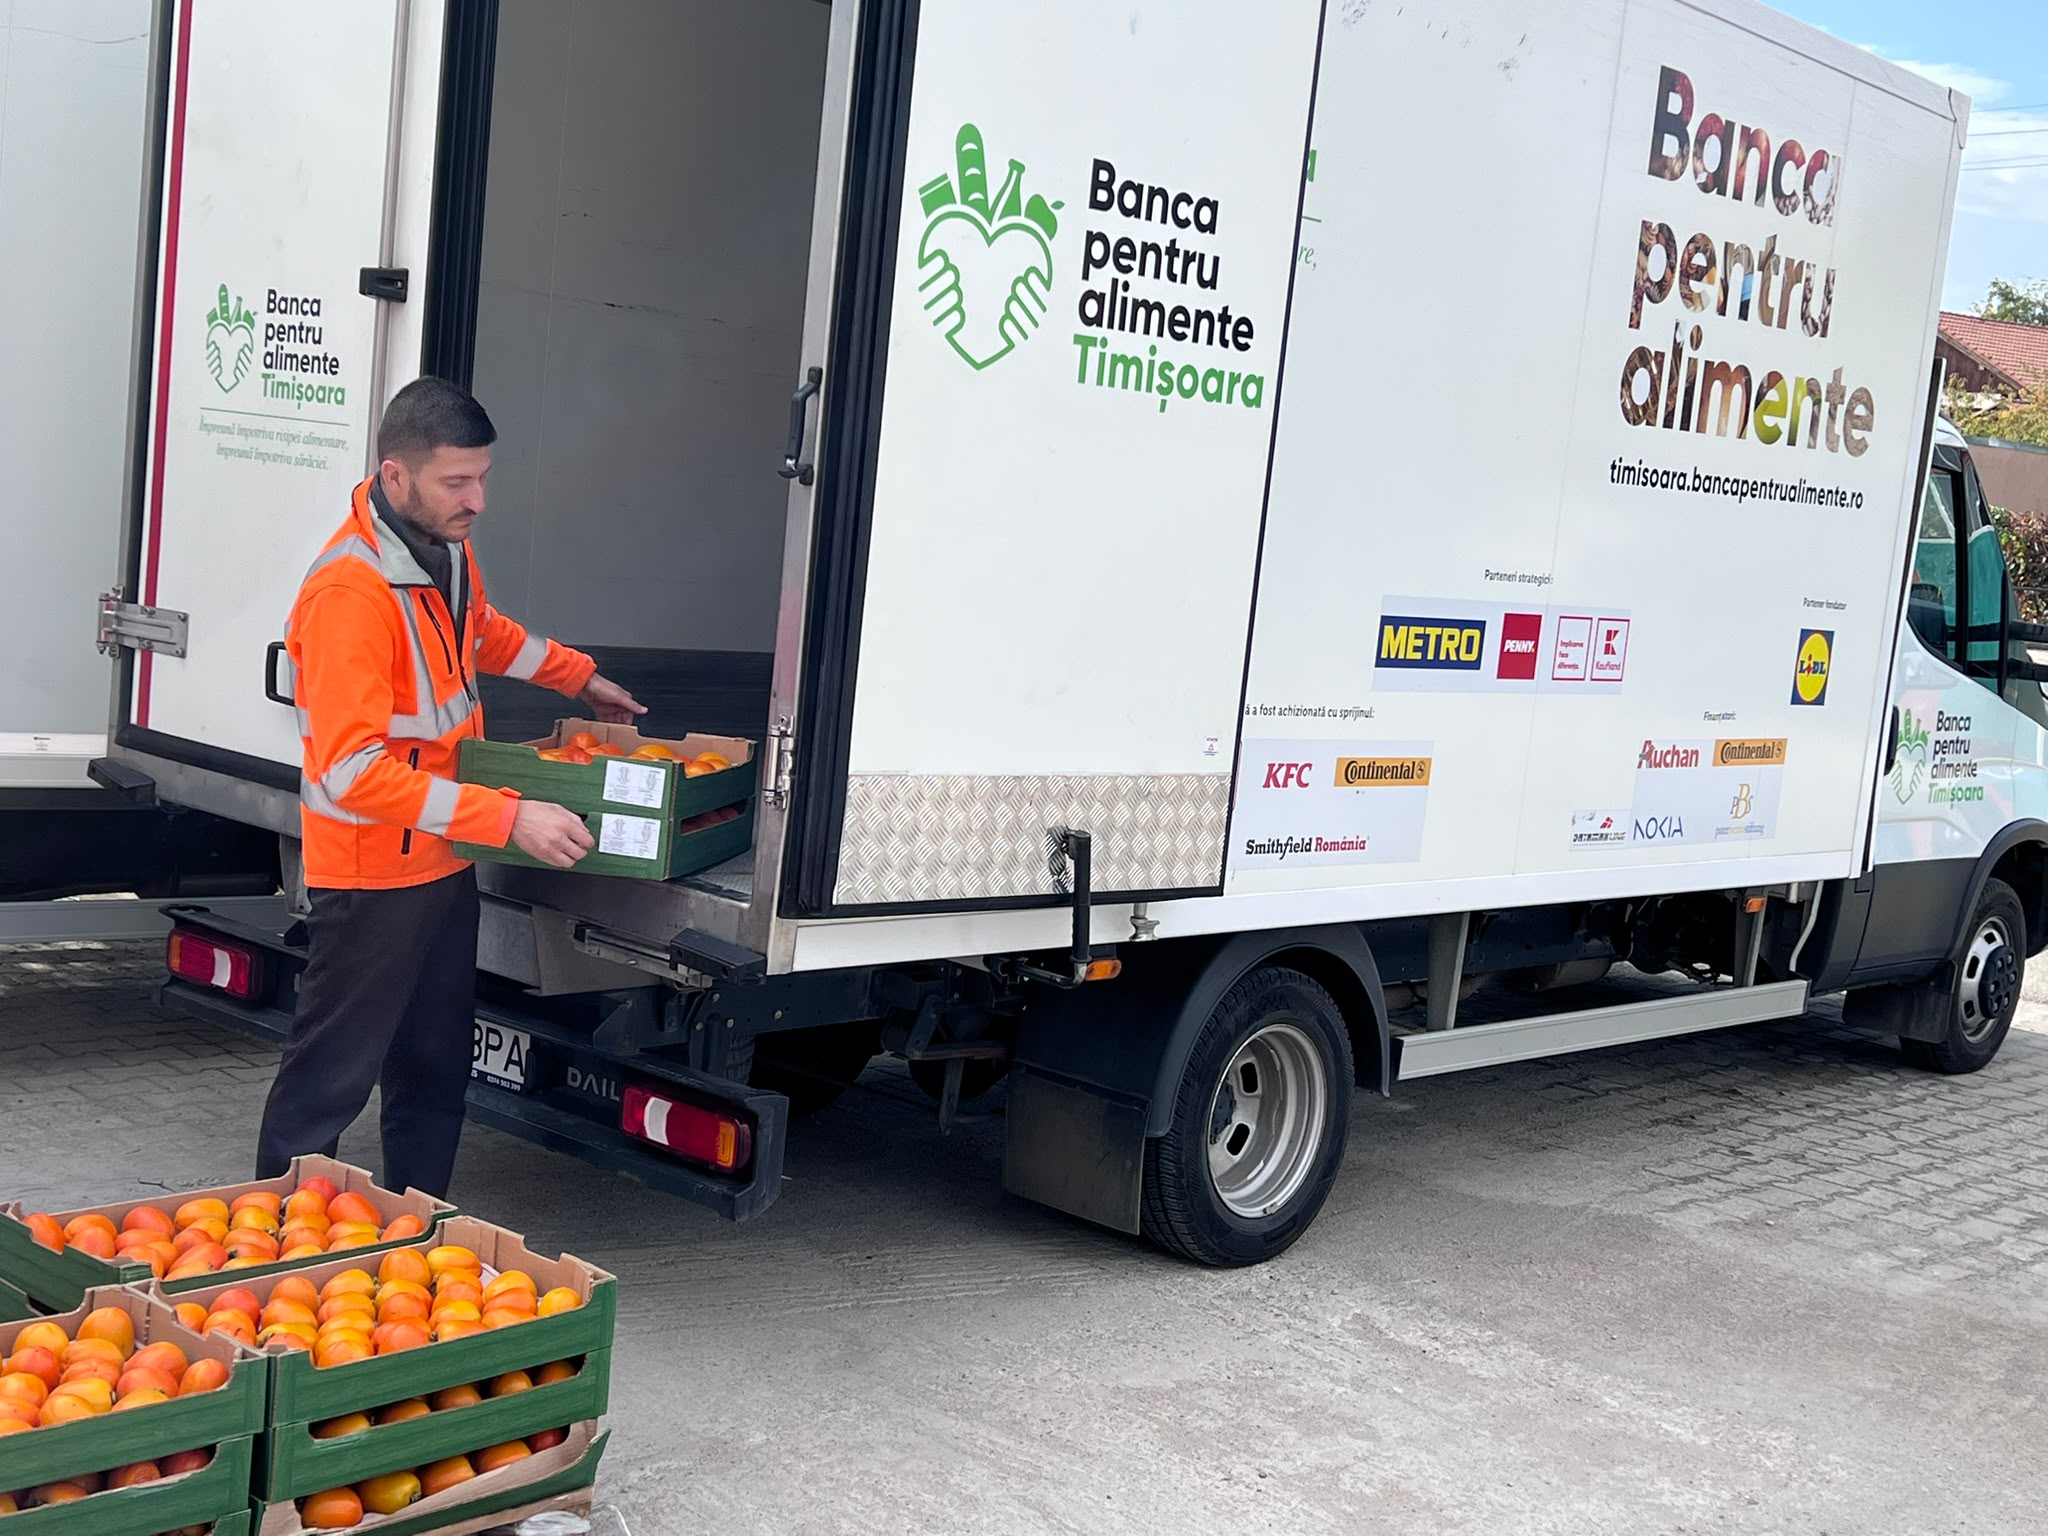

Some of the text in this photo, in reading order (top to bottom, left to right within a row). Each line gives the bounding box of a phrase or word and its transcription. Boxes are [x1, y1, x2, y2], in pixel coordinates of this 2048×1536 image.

[1648, 64, 1841, 227] Banca
[1088, 158, 1219, 235] Banca
[1081, 229, 1220, 290] pentru
[1628, 219, 1836, 338] pentru
[266, 289, 321, 317] Banca
[1078, 278, 1254, 352] alimente
[264, 321, 322, 347] pentru
[263, 344, 340, 376] alimente
[1073, 334, 1265, 413] Timișoara
[261, 373, 346, 410] Timișoara
[1620, 318, 1875, 457] alimente
[1609, 457, 1864, 510] timisoara.bancapentrualimente.ro
[1380, 625, 1481, 662] METRO
[1252, 706, 1257, 715] a
[1260, 704, 1276, 716] fost
[1328, 708, 1337, 718] cu
[1936, 711, 1971, 732] Banca
[1637, 740, 1699, 769] Auchan
[1720, 742, 1775, 764] Continental
[1933, 736, 1971, 760] pentru
[1262, 763, 1313, 788] KFC
[1344, 760, 1416, 784] Continental
[1931, 758, 1977, 779] alimente
[1928, 782, 1984, 809] Timișoara
[1633, 816, 1684, 840] NOKIA
[1245, 835, 1367, 860] Smithfield România
